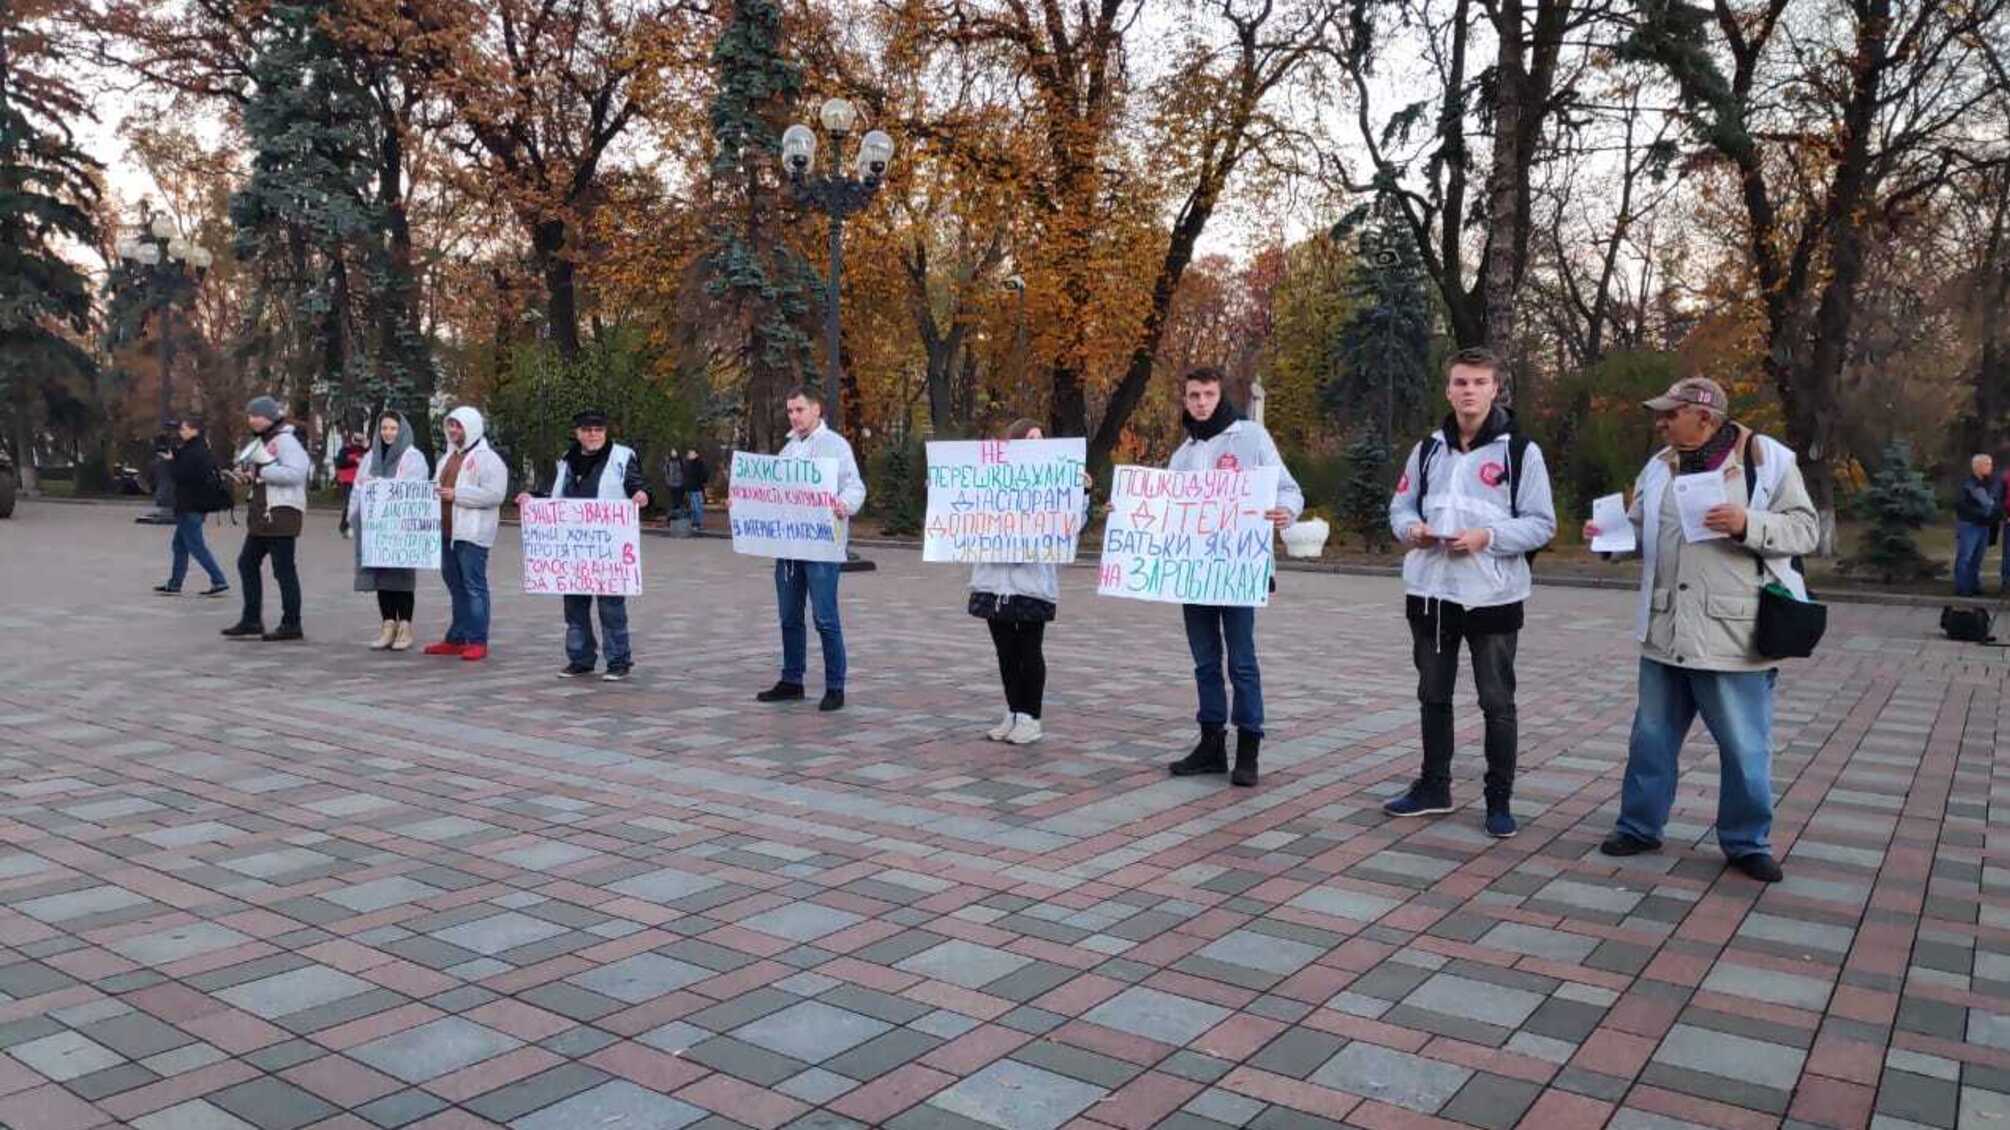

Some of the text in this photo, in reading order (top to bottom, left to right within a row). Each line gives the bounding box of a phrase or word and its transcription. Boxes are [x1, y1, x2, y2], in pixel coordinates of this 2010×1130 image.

[982, 440, 1009, 464] НЕ
[736, 456, 822, 484] ЗАХИСТІТЬ
[1117, 468, 1251, 499] ПОШКОДУЙТЕ
[951, 488, 1071, 513] ДІАСПОРАМ
[926, 512, 1077, 539] ДОПОМАГАТИ
[1108, 528, 1270, 559] БАТЬКИ ЯКИХ
[1098, 562, 1121, 588] НА
